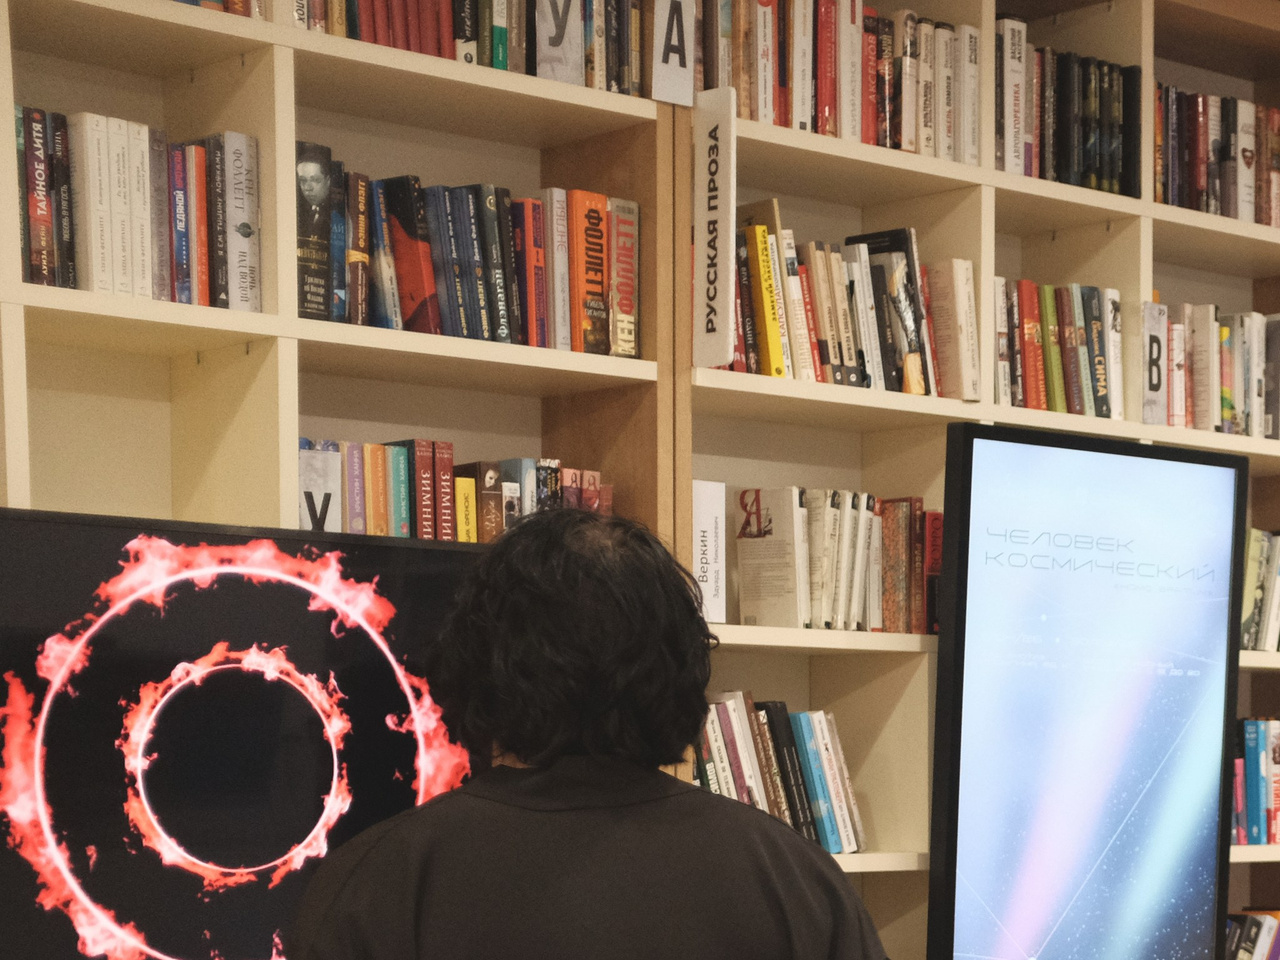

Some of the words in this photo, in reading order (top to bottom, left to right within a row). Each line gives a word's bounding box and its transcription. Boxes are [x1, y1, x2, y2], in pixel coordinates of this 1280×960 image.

[662, 0, 688, 68] А
[32, 121, 44, 160] ДИТЯ
[36, 161, 46, 216] ТАЙНОЕ
[232, 149, 245, 212] ФОЛЛЕТТ
[706, 123, 720, 212] ПРОЗА
[173, 191, 186, 231] ЛЕДЯНОЙ
[358, 179, 366, 212] ФЛЭГГ
[358, 214, 366, 248] ФЭННИ
[584, 208, 604, 299] ФОЛЛЕТТ
[41, 249, 49, 275] ЛУИЗА
[616, 215, 635, 315] ФОЛЛЕТТ
[704, 220, 720, 335] РУССКАЯ
[495, 269, 508, 337] Флэнаган
[617, 314, 635, 356] КЕН
[1149, 334, 1162, 393] В
[698, 529, 709, 584] Веркин
[712, 515, 720, 565] Николаевич
[986, 526, 1135, 554] ЧЕЛОВЕК
[712, 569, 720, 600] Эдуард
[985, 551, 1216, 582] КОСМИЧЕСКИЙ
